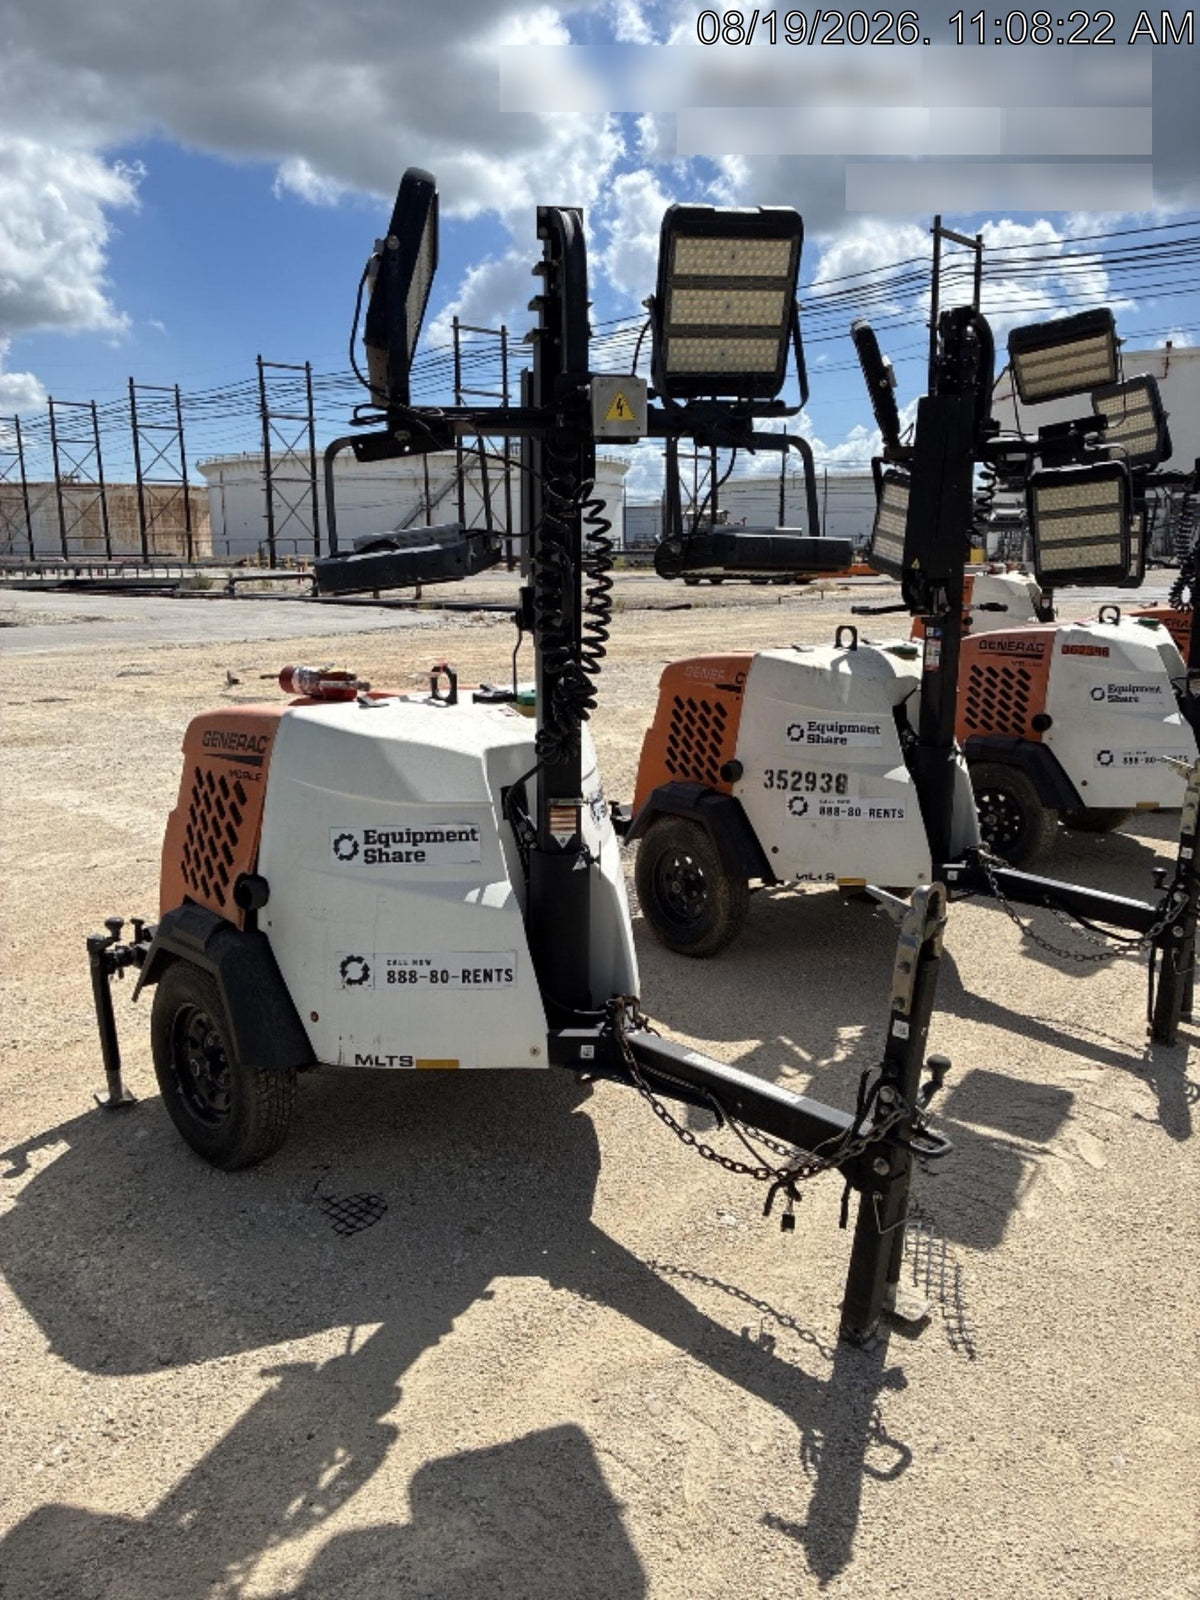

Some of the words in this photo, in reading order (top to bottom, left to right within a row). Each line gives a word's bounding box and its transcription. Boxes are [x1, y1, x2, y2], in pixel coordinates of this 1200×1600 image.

[978, 639, 1046, 653] GENERAC
[806, 721, 880, 735] Equipment
[202, 730, 270, 754] GENERAC
[806, 733, 848, 745] Share
[819, 806, 904, 819] 888-80-RENTS
[363, 828, 479, 848] Equipment
[363, 848, 426, 865] Share
[386, 968, 513, 984] 888-80-RENTS
[354, 1053, 413, 1067] MLTS
